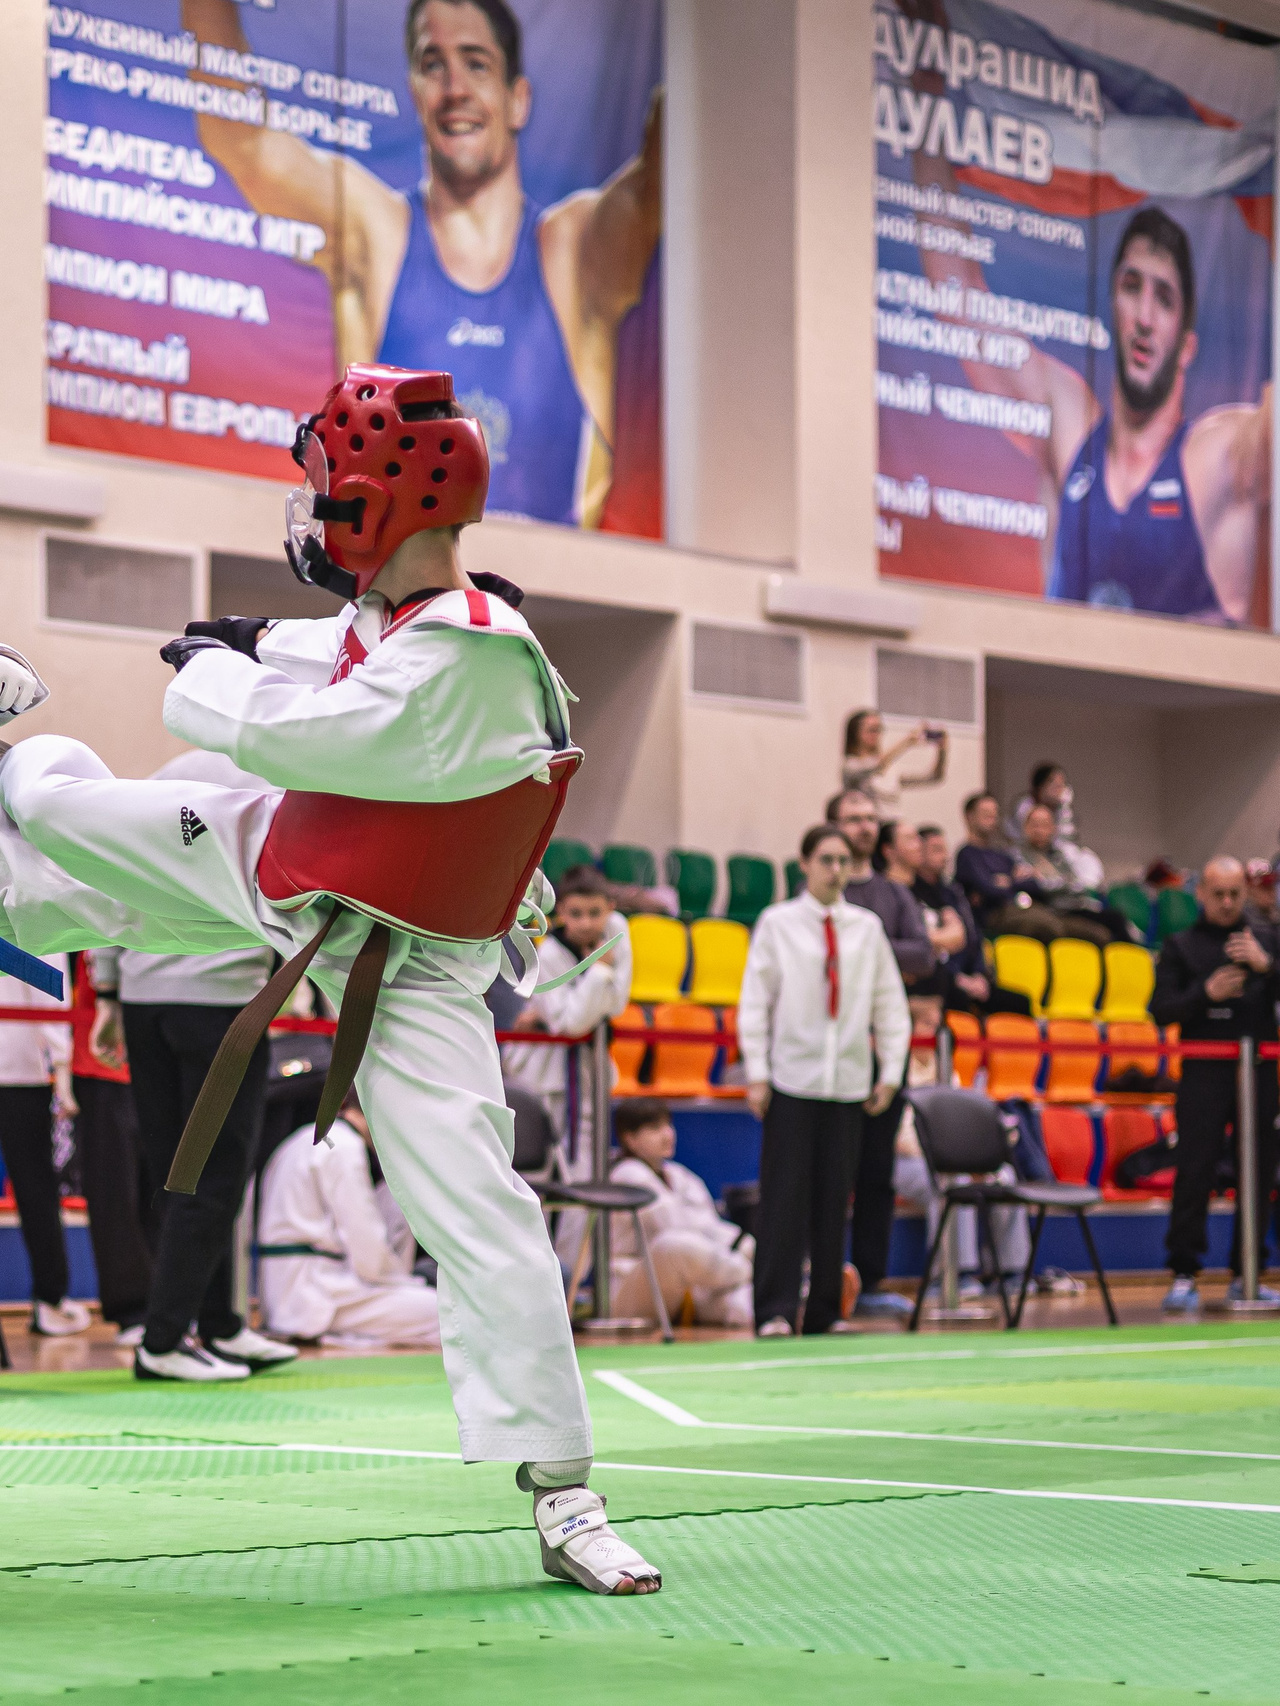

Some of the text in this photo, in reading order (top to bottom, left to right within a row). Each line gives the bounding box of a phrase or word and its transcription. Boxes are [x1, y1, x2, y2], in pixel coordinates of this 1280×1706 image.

[200, 43, 301, 91] МАСТЕР
[302, 69, 400, 117] СПОРТА
[269, 100, 372, 149] БОРЬБЕ
[259, 213, 327, 260] ИГР
[171, 269, 270, 326] МИРА
[934, 382, 1052, 439] ЧЕМПИОН
[933, 486, 1048, 540] ЧЕМПИОН
[180, 806, 192, 846] adidas
